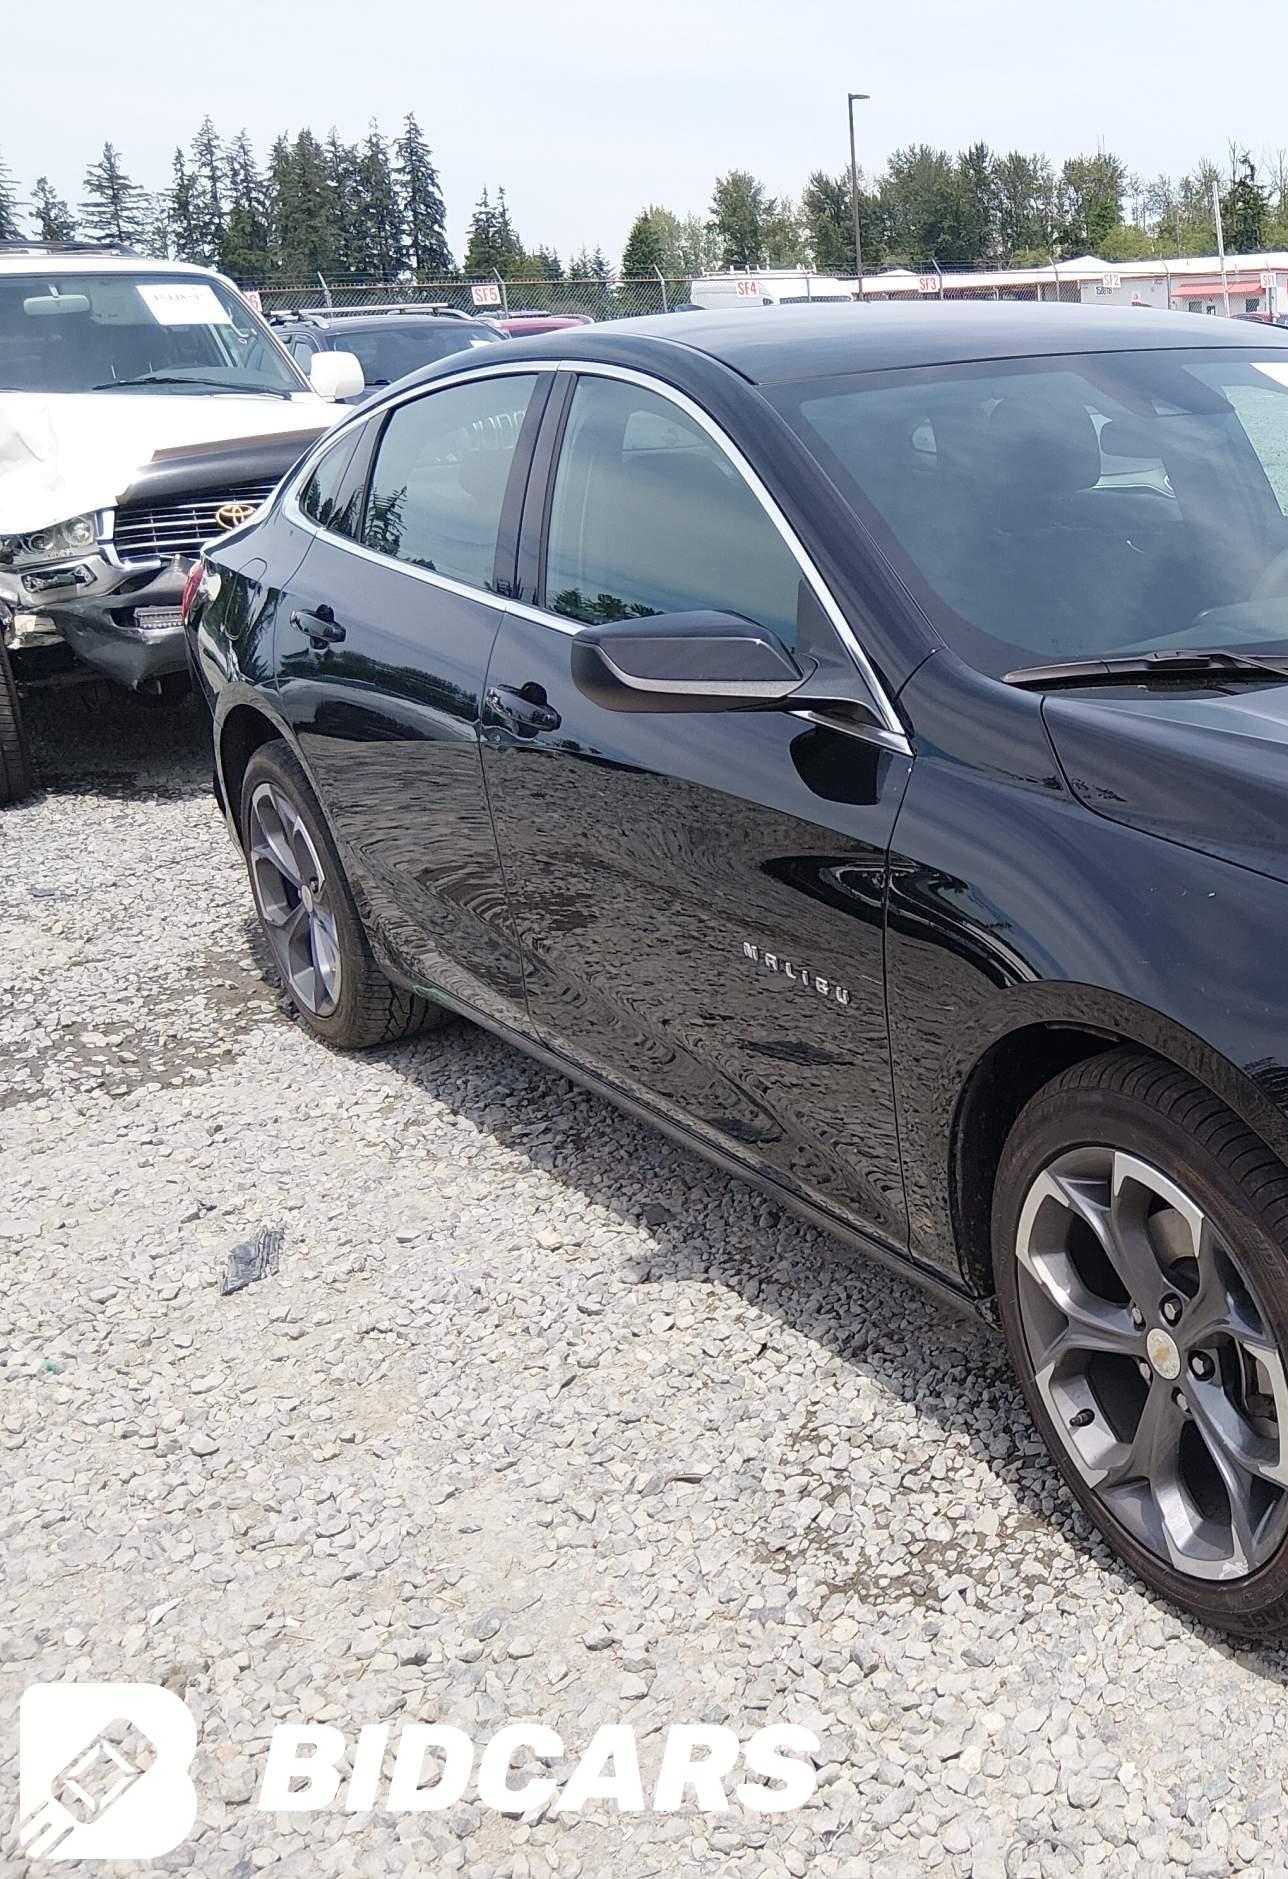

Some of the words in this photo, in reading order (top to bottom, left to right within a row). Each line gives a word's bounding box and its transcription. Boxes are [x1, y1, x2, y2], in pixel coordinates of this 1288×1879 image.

[920, 277, 937, 291] SF3
[1103, 274, 1119, 286] SF2
[474, 287, 498, 302] SF5
[737, 281, 757, 296] SF4
[742, 941, 850, 1005] MALIBU
